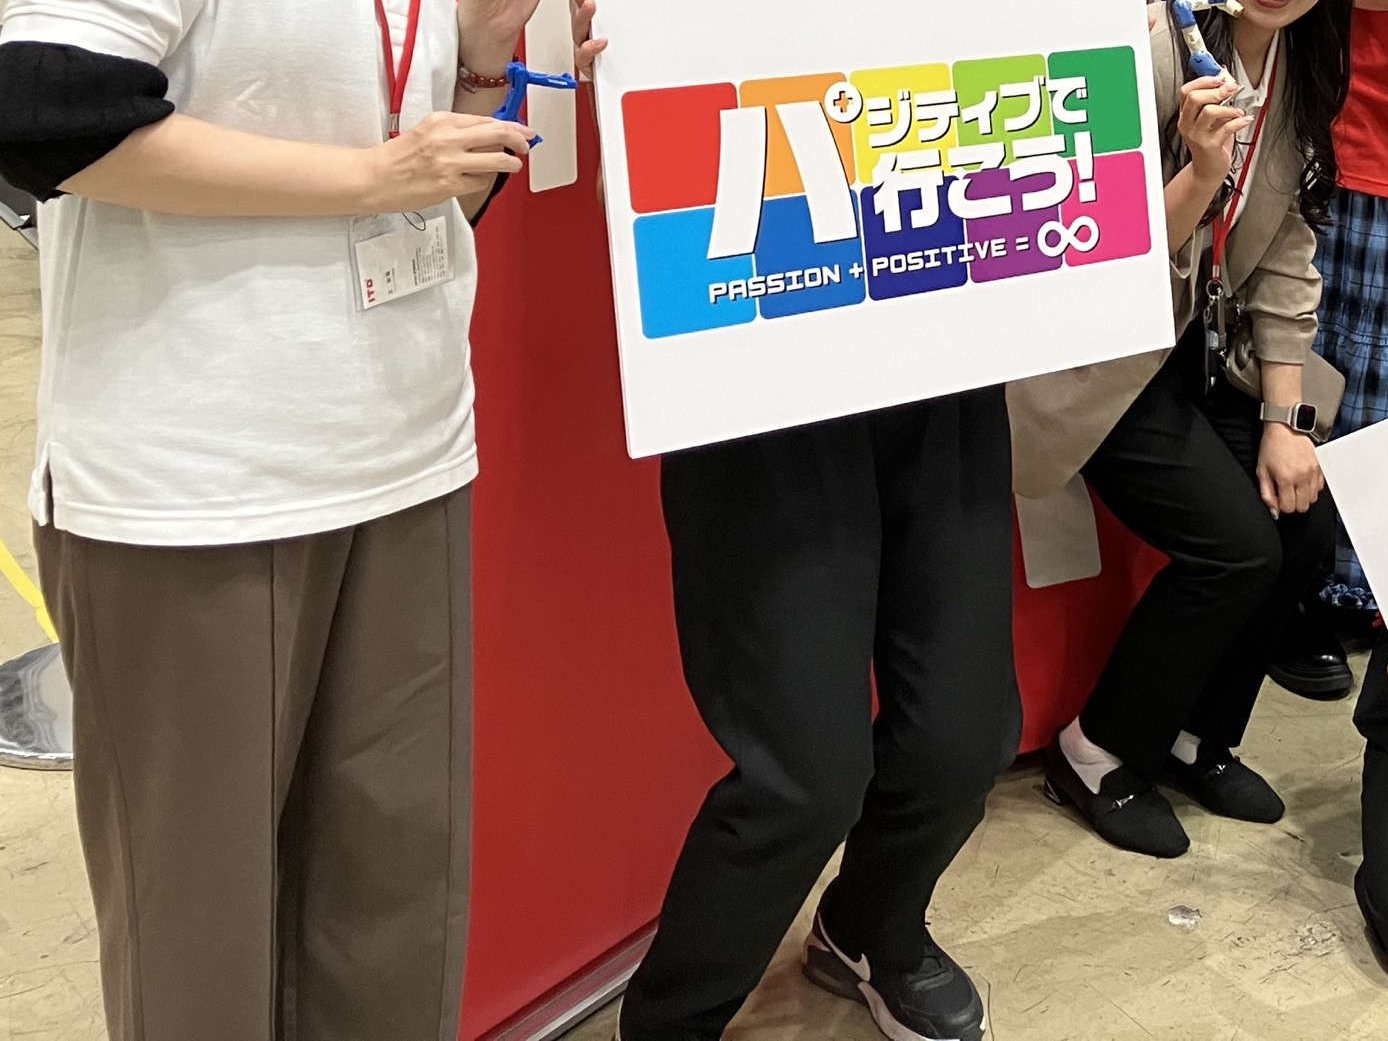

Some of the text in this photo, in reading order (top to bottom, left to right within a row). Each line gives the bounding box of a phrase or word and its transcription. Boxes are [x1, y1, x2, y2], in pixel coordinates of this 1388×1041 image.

[866, 75, 1089, 149] ジティブで
[871, 130, 1100, 234] 行こう!
[707, 263, 842, 304] PASSION
[871, 237, 1008, 278] POSITIVE
